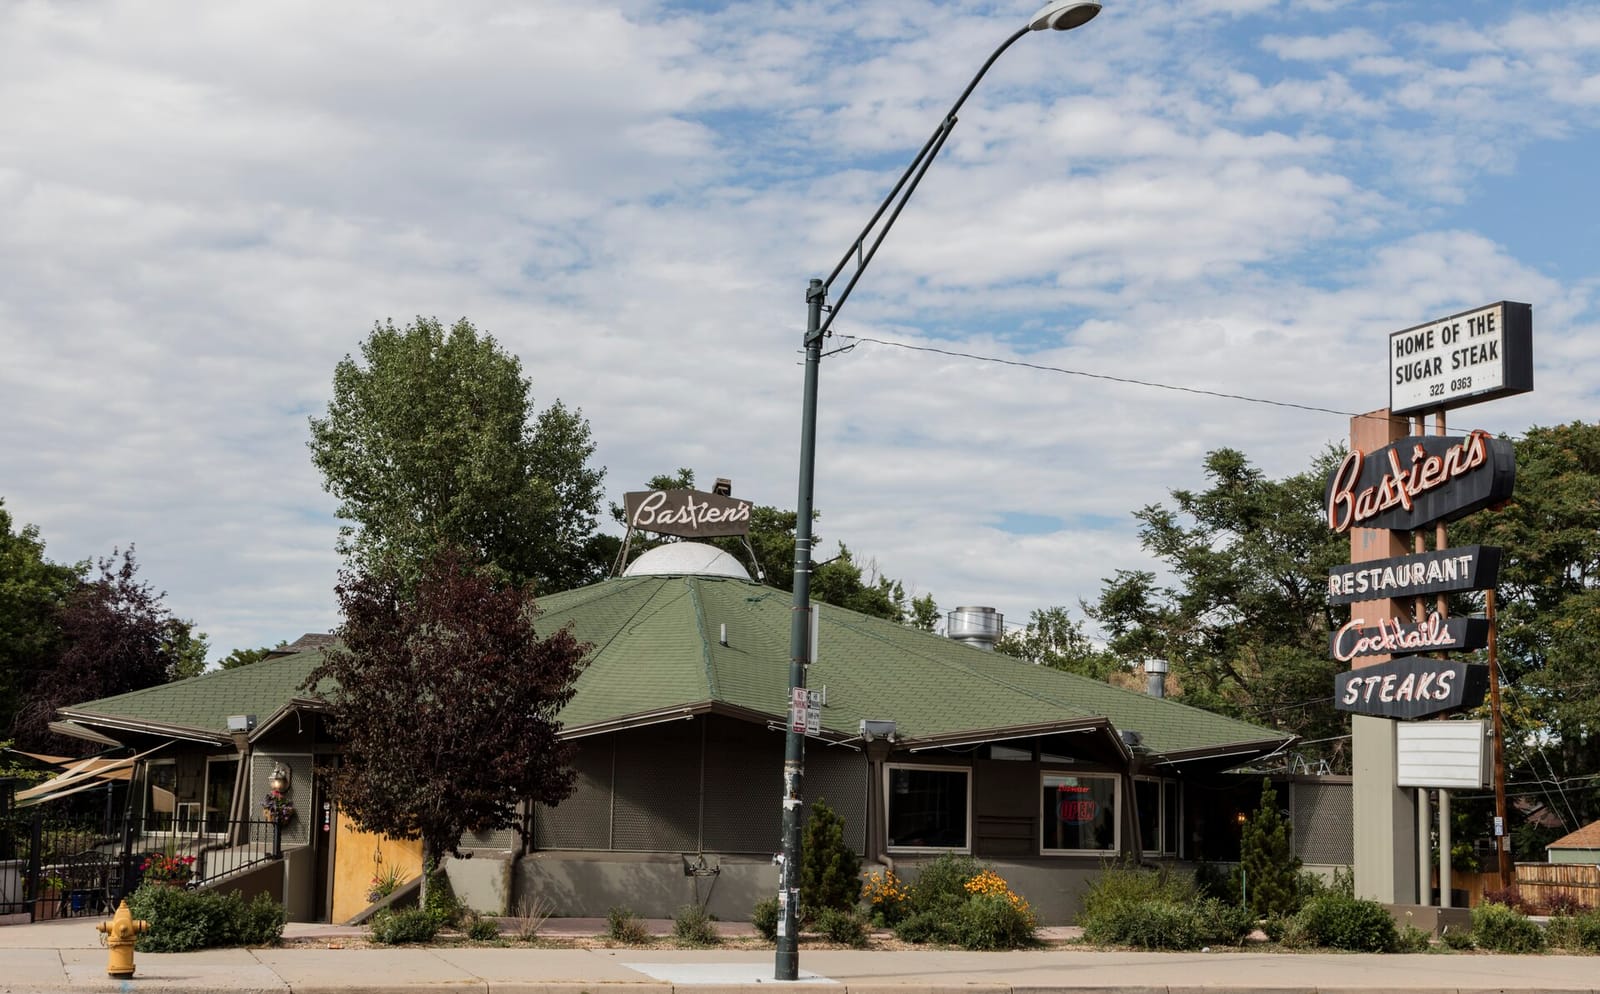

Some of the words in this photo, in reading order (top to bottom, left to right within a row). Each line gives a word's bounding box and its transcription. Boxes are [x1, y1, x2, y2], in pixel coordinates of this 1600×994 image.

[1396, 330, 1434, 358] HOME
[1442, 323, 1460, 345] OF
[1468, 312, 1495, 337] THE
[1396, 357, 1442, 385] SUGAR
[1452, 340, 1498, 370] STEAK
[1429, 383, 1445, 396] 322
[1451, 376, 1472, 391] 0363
[1328, 429, 1491, 533] Bastien's
[633, 491, 749, 529] Bastien's
[1328, 555, 1473, 597] RESTAURANT
[1333, 612, 1456, 662] Cocktails
[1342, 670, 1456, 704] STEAKS
[1061, 800, 1096, 820] OPEN
